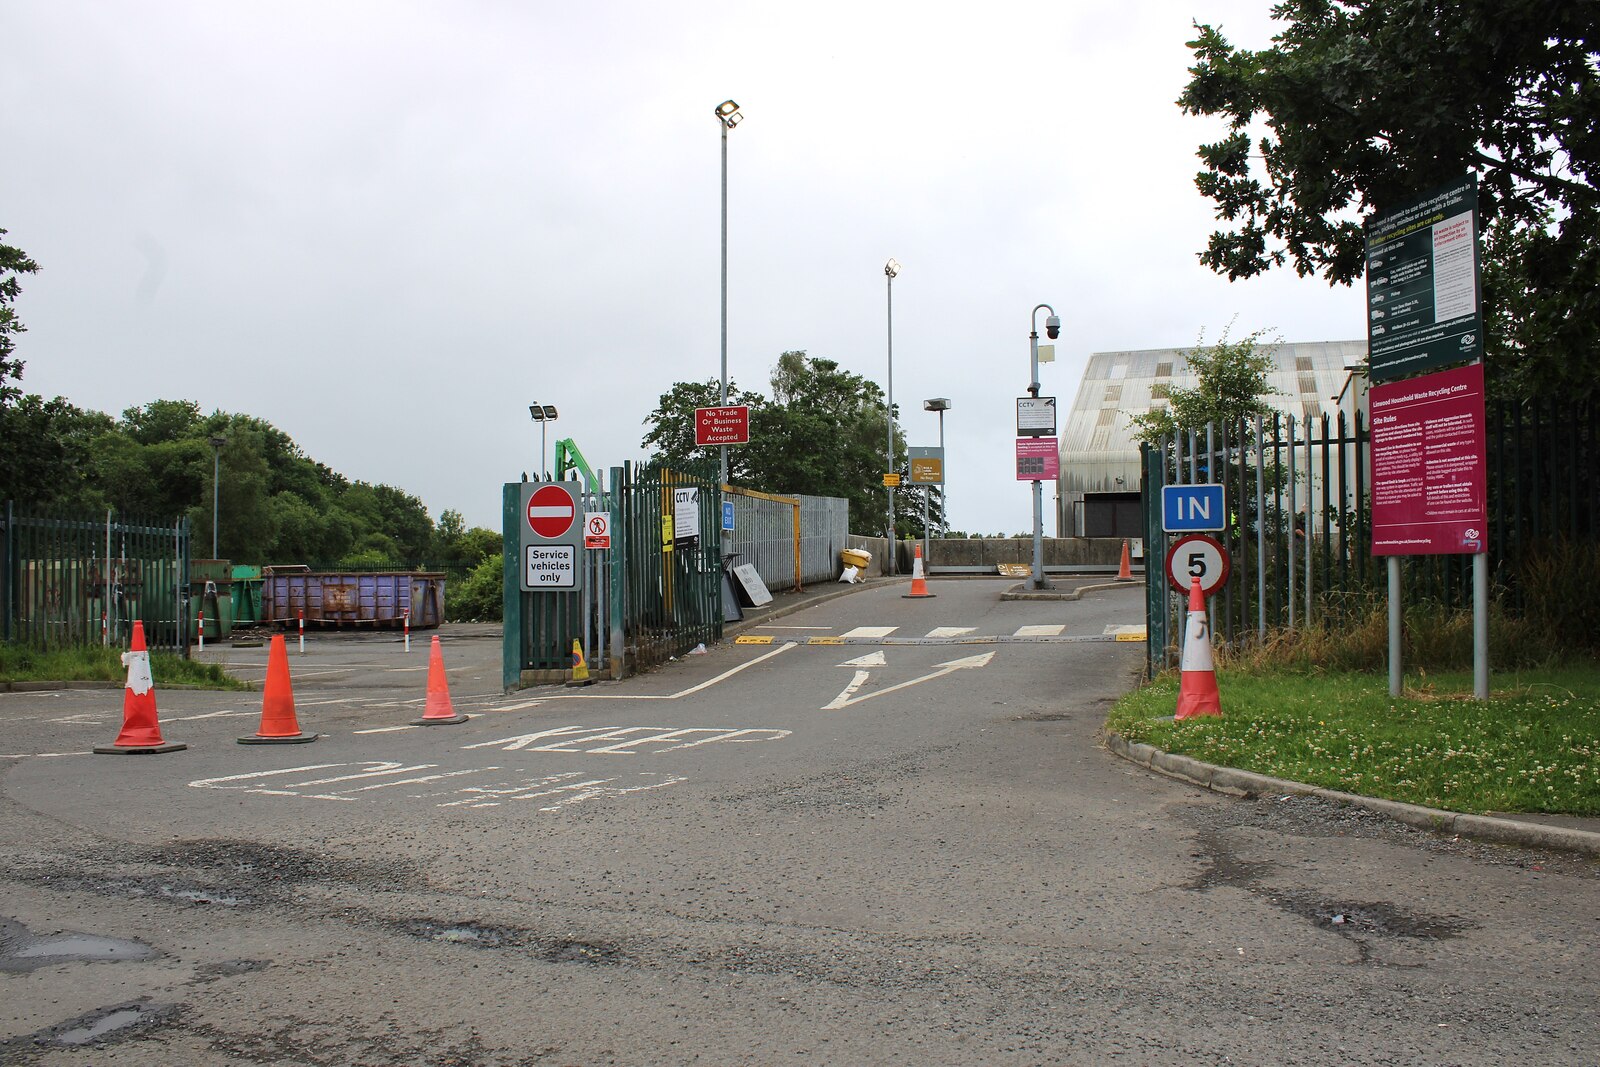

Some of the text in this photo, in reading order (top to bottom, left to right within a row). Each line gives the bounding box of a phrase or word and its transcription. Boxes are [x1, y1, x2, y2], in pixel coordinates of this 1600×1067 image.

[1390, 209, 1404, 222] permit
[1428, 192, 1449, 205] recycling
[1449, 186, 1464, 197] centre
[1397, 215, 1414, 227] minibus
[1432, 202, 1442, 213] with
[1447, 196, 1463, 207] trailer.
[1387, 228, 1406, 240] recycling
[1406, 224, 1416, 232] sites
[1433, 213, 1444, 222] only.
[1373, 399, 1390, 408] Linwood
[1391, 394, 1413, 404] Household
[1429, 388, 1450, 397] Recycling
[1451, 384, 1467, 392] Centre
[706, 434, 738, 442] Accepted
[676, 492, 690, 503] CCTV
[1178, 496, 1210, 520] IN
[531, 562, 570, 570] vehicles
[532, 550, 569, 559] Service
[1188, 553, 1206, 577] 5
[540, 573, 560, 582] only
[460, 725, 793, 754] KEEP
